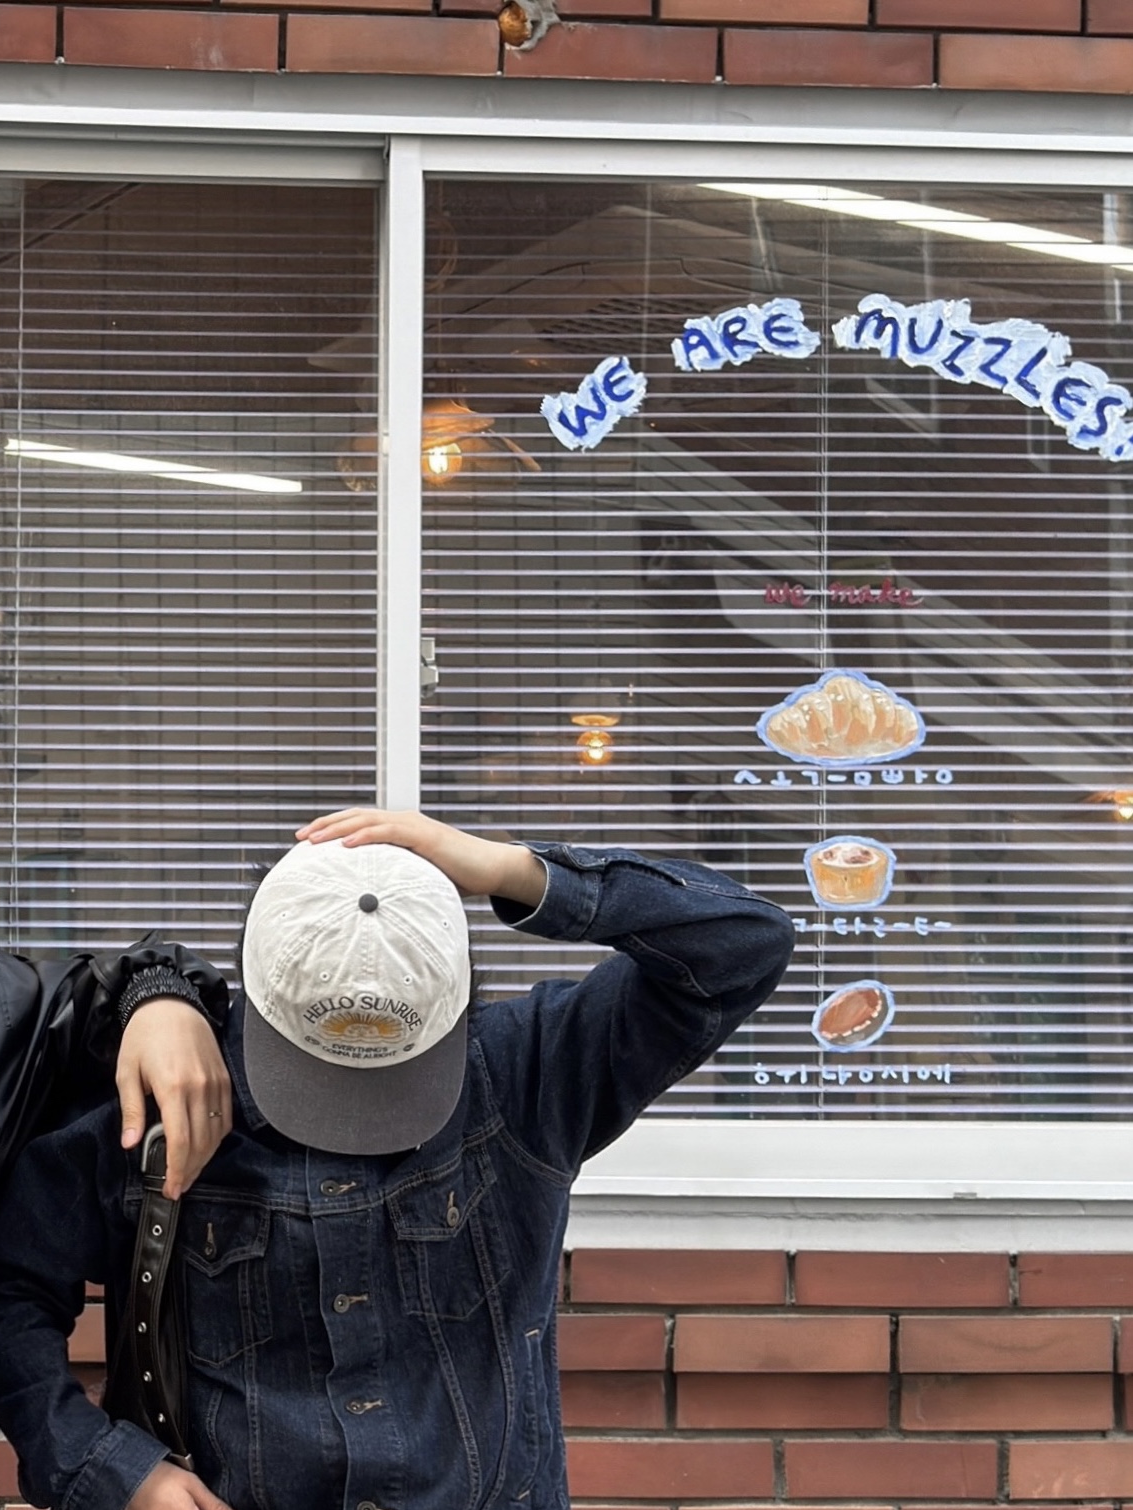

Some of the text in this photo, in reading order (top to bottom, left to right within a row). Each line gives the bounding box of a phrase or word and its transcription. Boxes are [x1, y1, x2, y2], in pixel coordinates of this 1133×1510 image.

[555, 359, 637, 440] WE
[680, 311, 802, 368] ARE
[765, 576, 924, 608] we make
[303, 996, 422, 1031] HELLO SUNRISE
